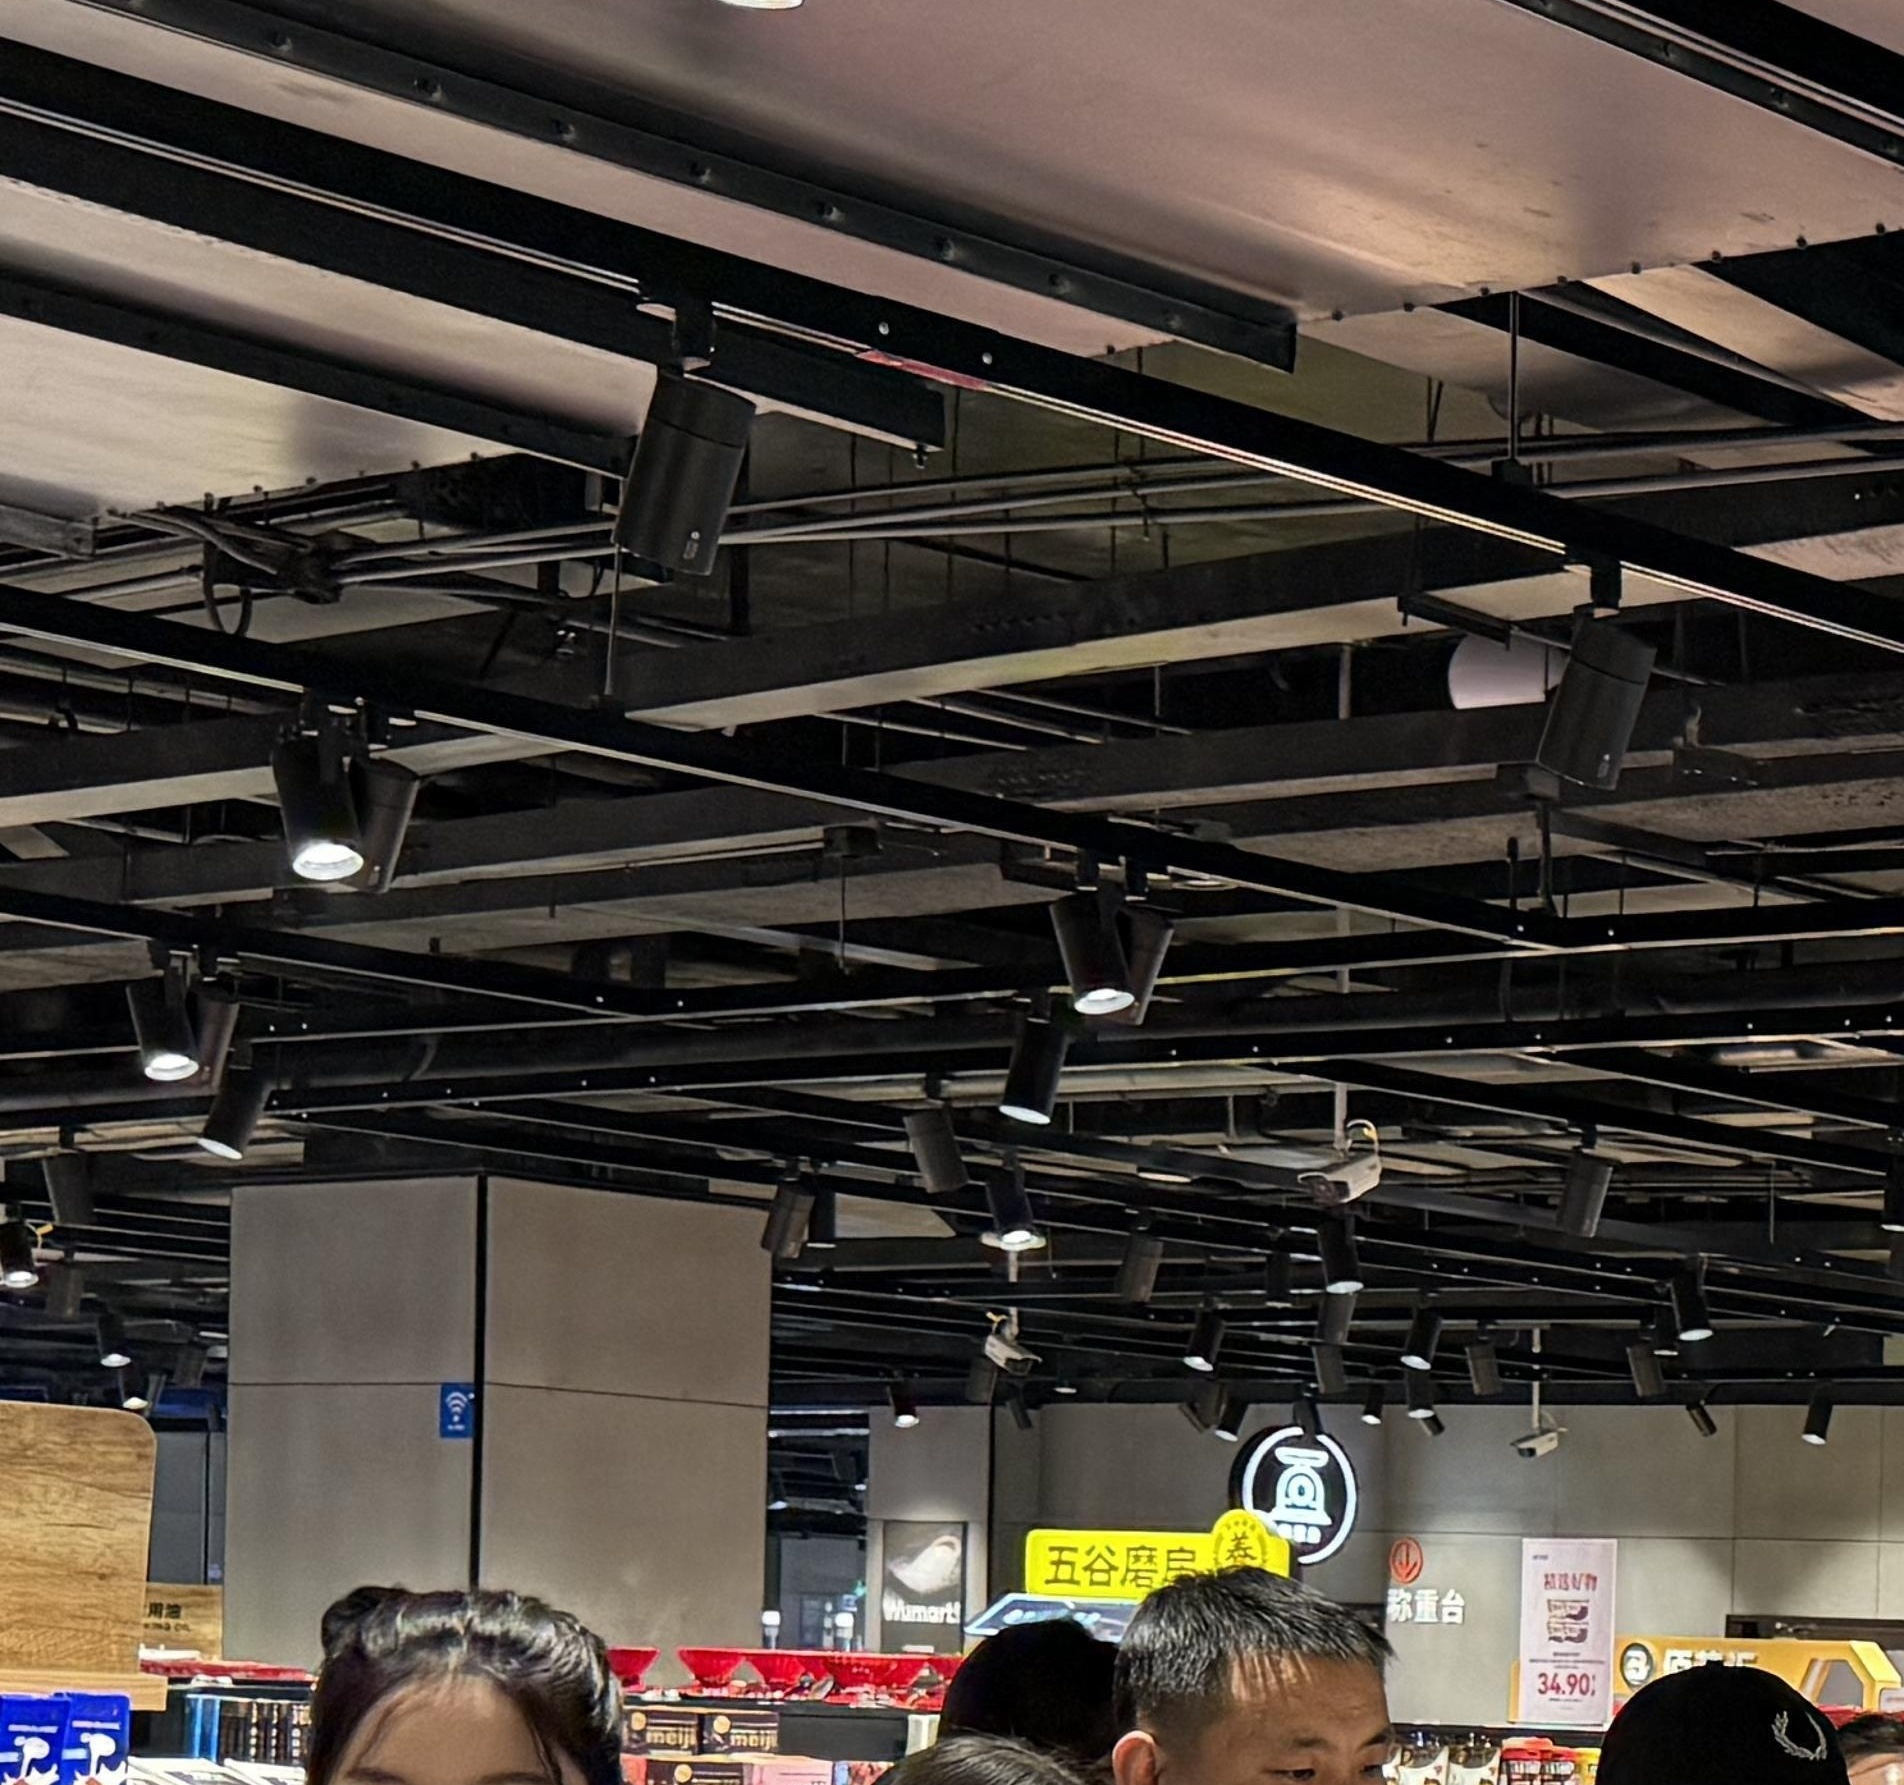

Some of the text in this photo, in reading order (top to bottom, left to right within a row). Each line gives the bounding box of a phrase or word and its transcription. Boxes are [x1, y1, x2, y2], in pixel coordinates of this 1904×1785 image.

[1386, 1588, 1466, 1625] 称重台
[1537, 1672, 1591, 1697] 34.90
